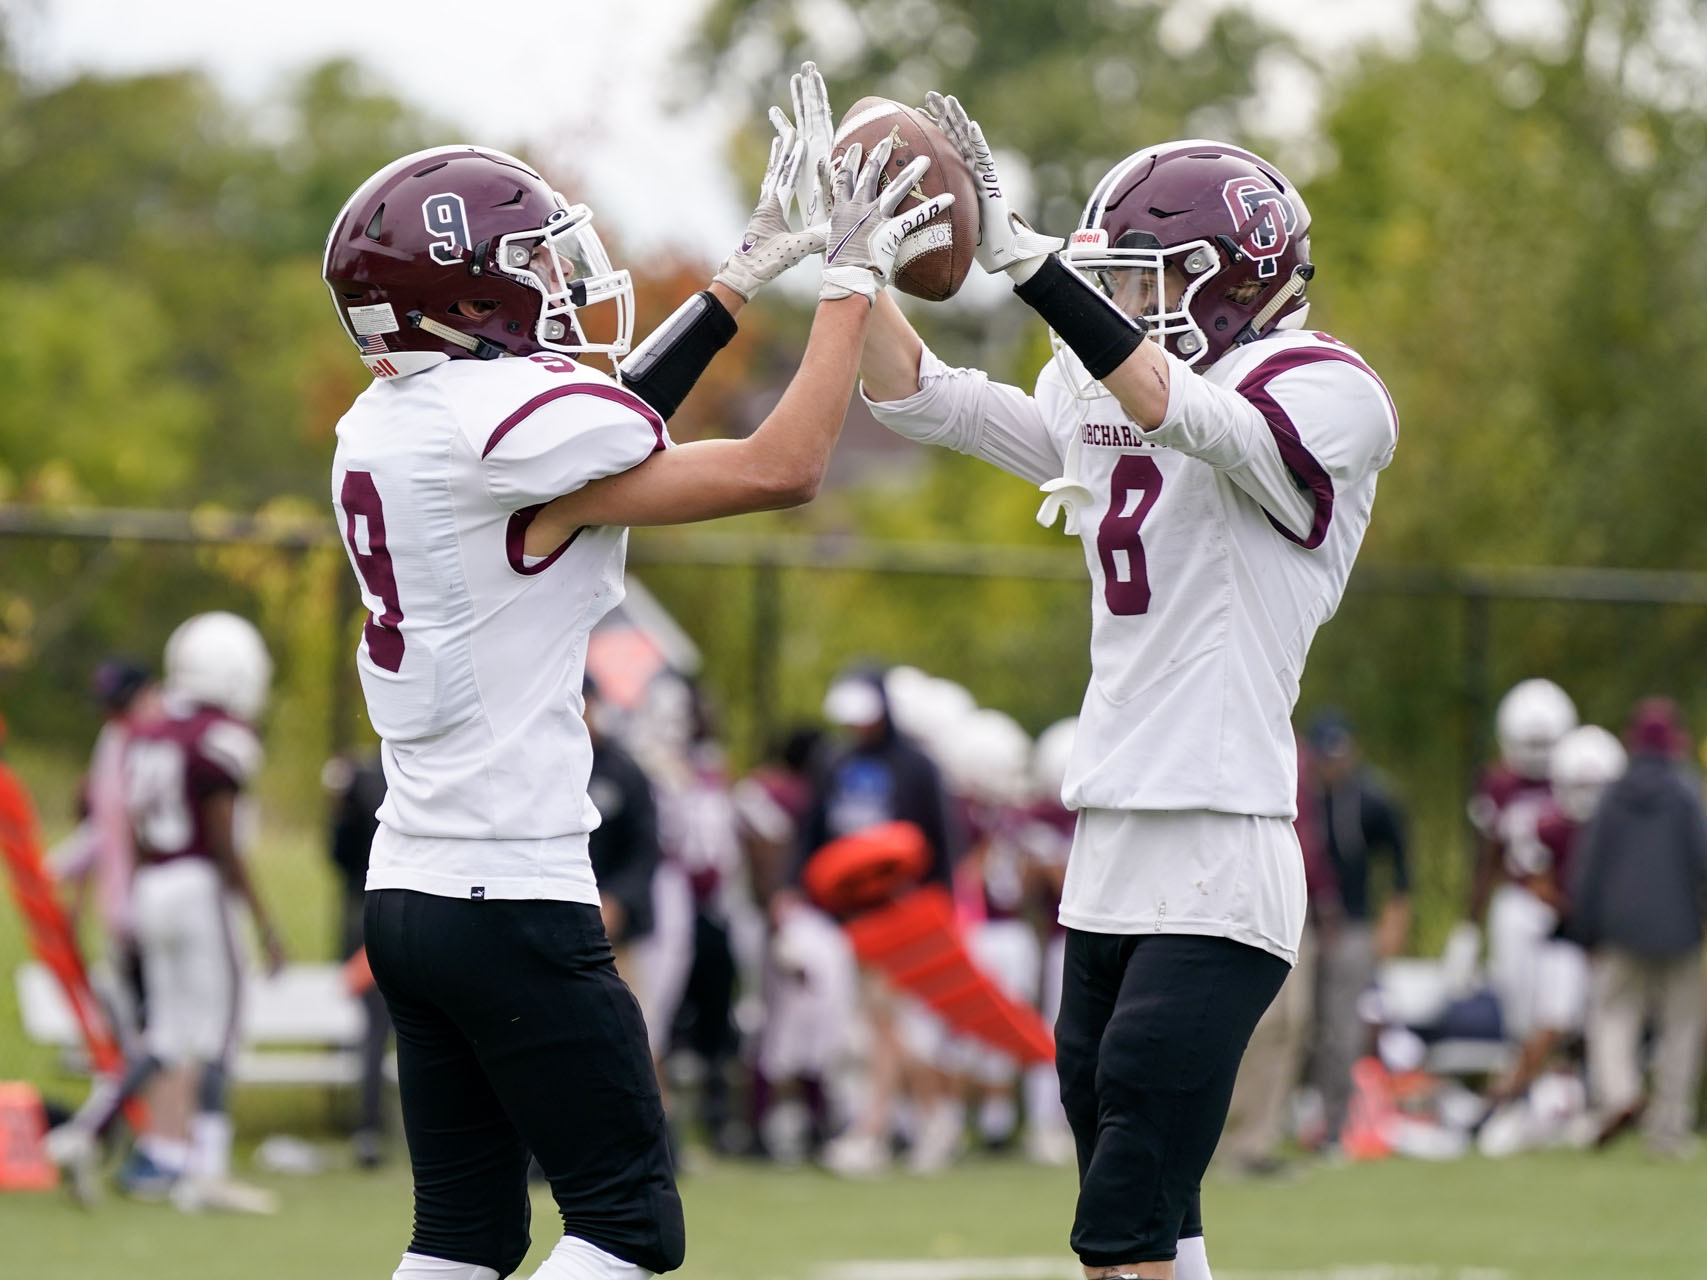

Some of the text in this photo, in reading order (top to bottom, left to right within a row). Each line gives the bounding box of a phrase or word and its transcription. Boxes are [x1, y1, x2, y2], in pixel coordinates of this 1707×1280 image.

[421, 192, 473, 266] 9
[340, 470, 406, 673] 9
[1097, 454, 1164, 616] 8
